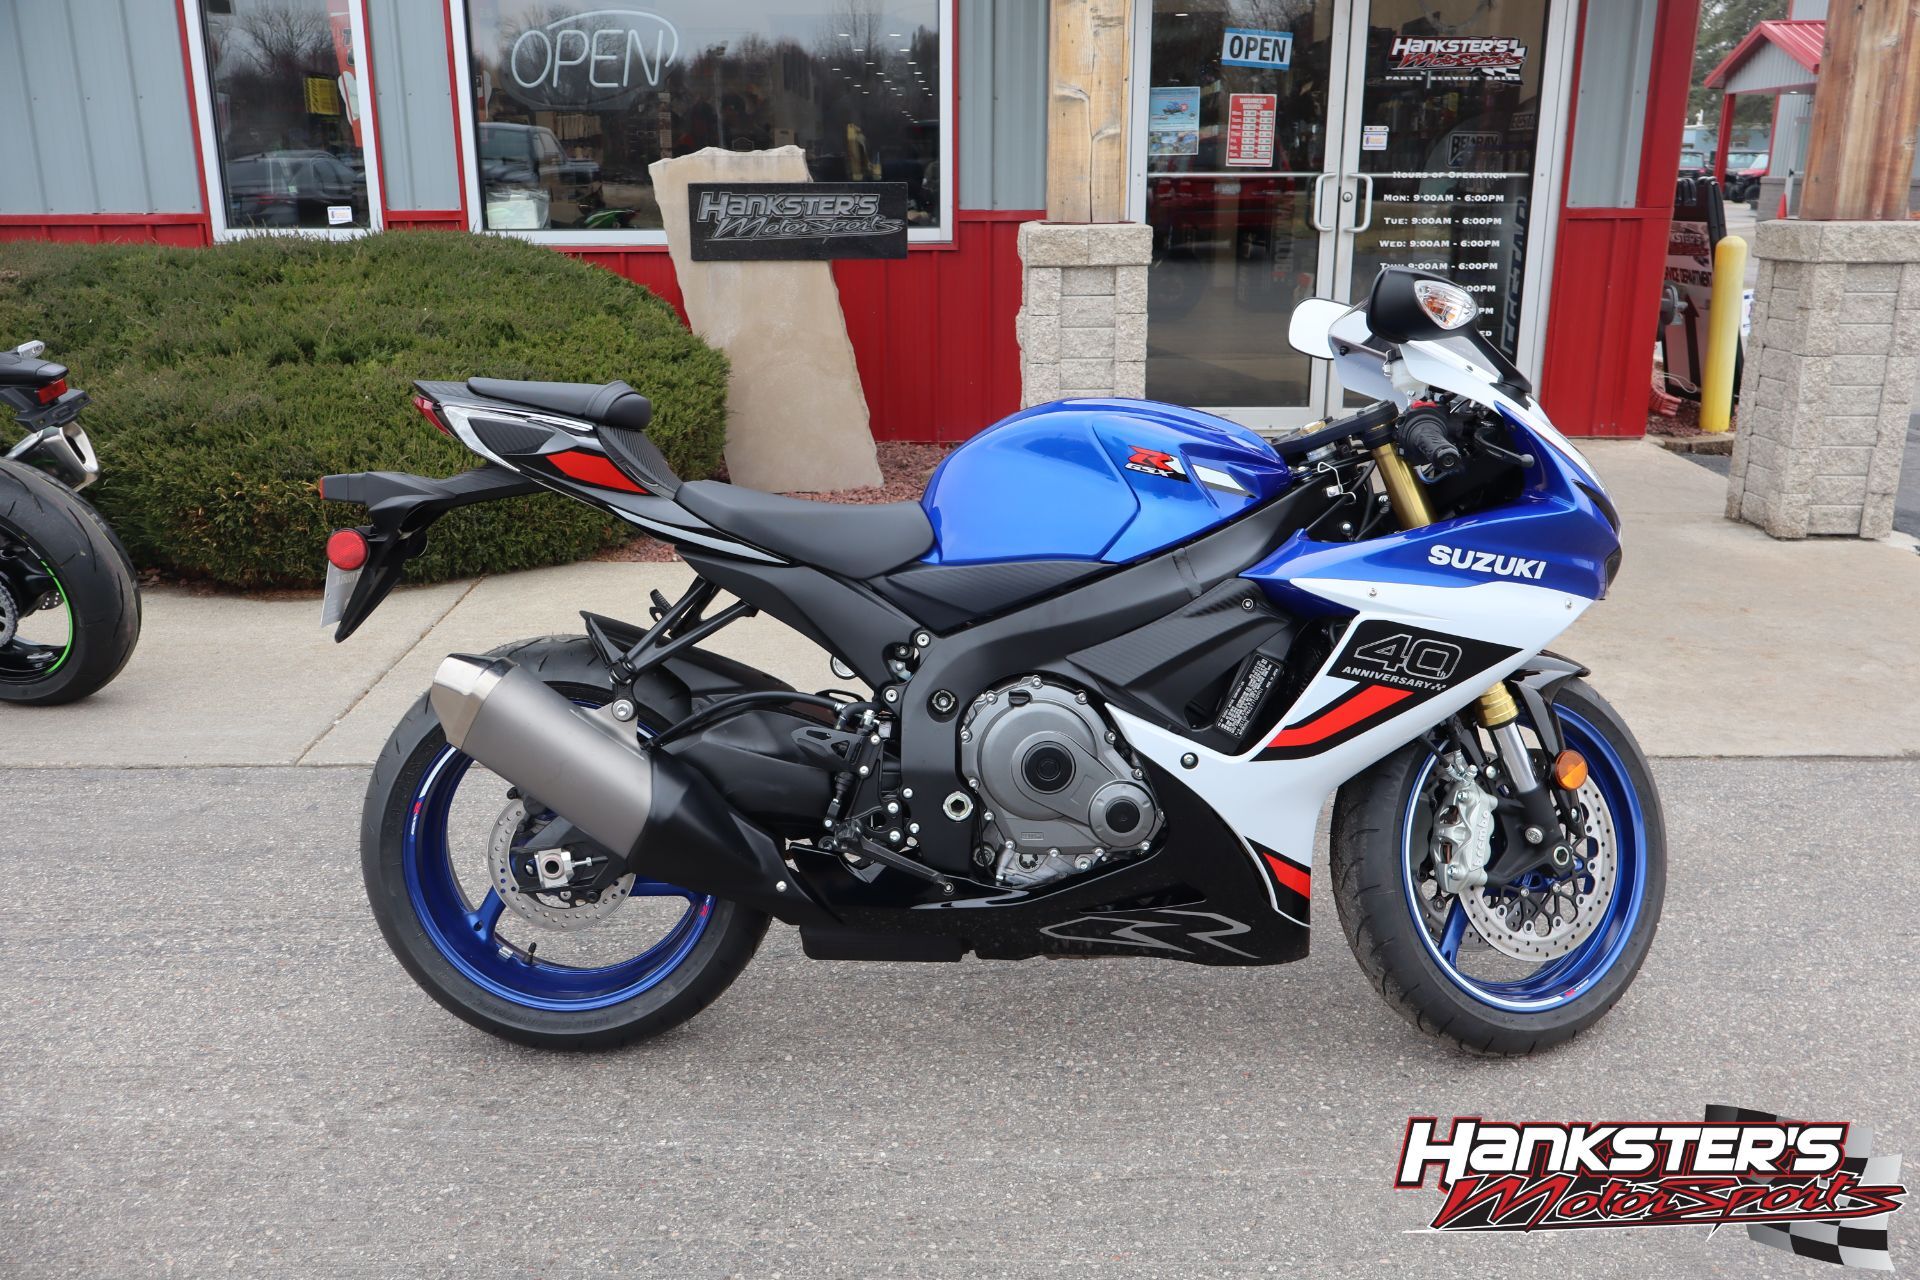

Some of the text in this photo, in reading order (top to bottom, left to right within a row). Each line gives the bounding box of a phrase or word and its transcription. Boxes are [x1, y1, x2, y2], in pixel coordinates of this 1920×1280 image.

[511, 29, 664, 89] OPEN
[1229, 35, 1286, 62] OPEN
[1412, 194, 1454, 202] 9:00AM
[1464, 194, 1505, 202] 6:00PM
[1411, 217, 1452, 225] 9:00AM
[1462, 217, 1502, 225] 6:00PM
[1409, 240, 1450, 248] 9:00AM
[1460, 240, 1500, 248] 6:00PM
[1427, 544, 1547, 580] SUZUKI
[1341, 666, 1435, 689] ANNIVERSARY
